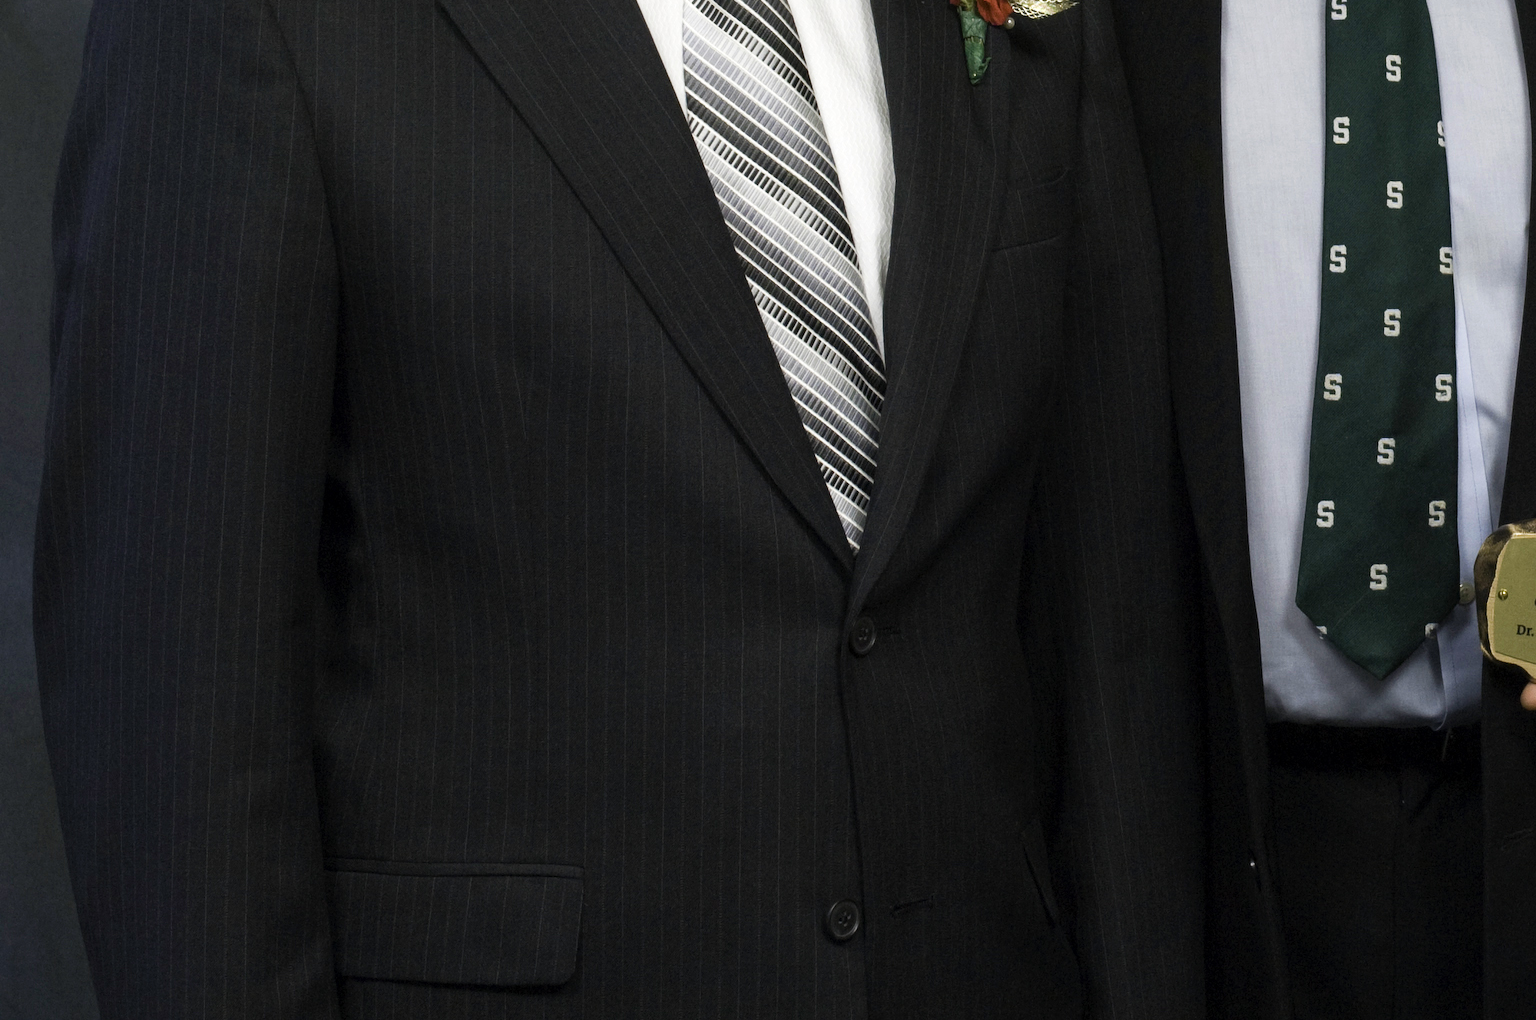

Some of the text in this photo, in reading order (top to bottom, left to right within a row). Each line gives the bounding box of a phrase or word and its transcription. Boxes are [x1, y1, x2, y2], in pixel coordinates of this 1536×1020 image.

[1385, 54, 1402, 83] S
[1332, 116, 1350, 145] S
[1386, 181, 1403, 209] S
[1329, 244, 1347, 273] S
[1439, 246, 1453, 274] S
[1383, 308, 1401, 337] S
[1323, 373, 1343, 401] S
[1435, 373, 1453, 402] S
[1376, 437, 1396, 465] S
[1316, 500, 1335, 528] S
[1428, 500, 1446, 527] S
[1369, 563, 1388, 591] S
[1516, 624, 1535, 638] Dr.
